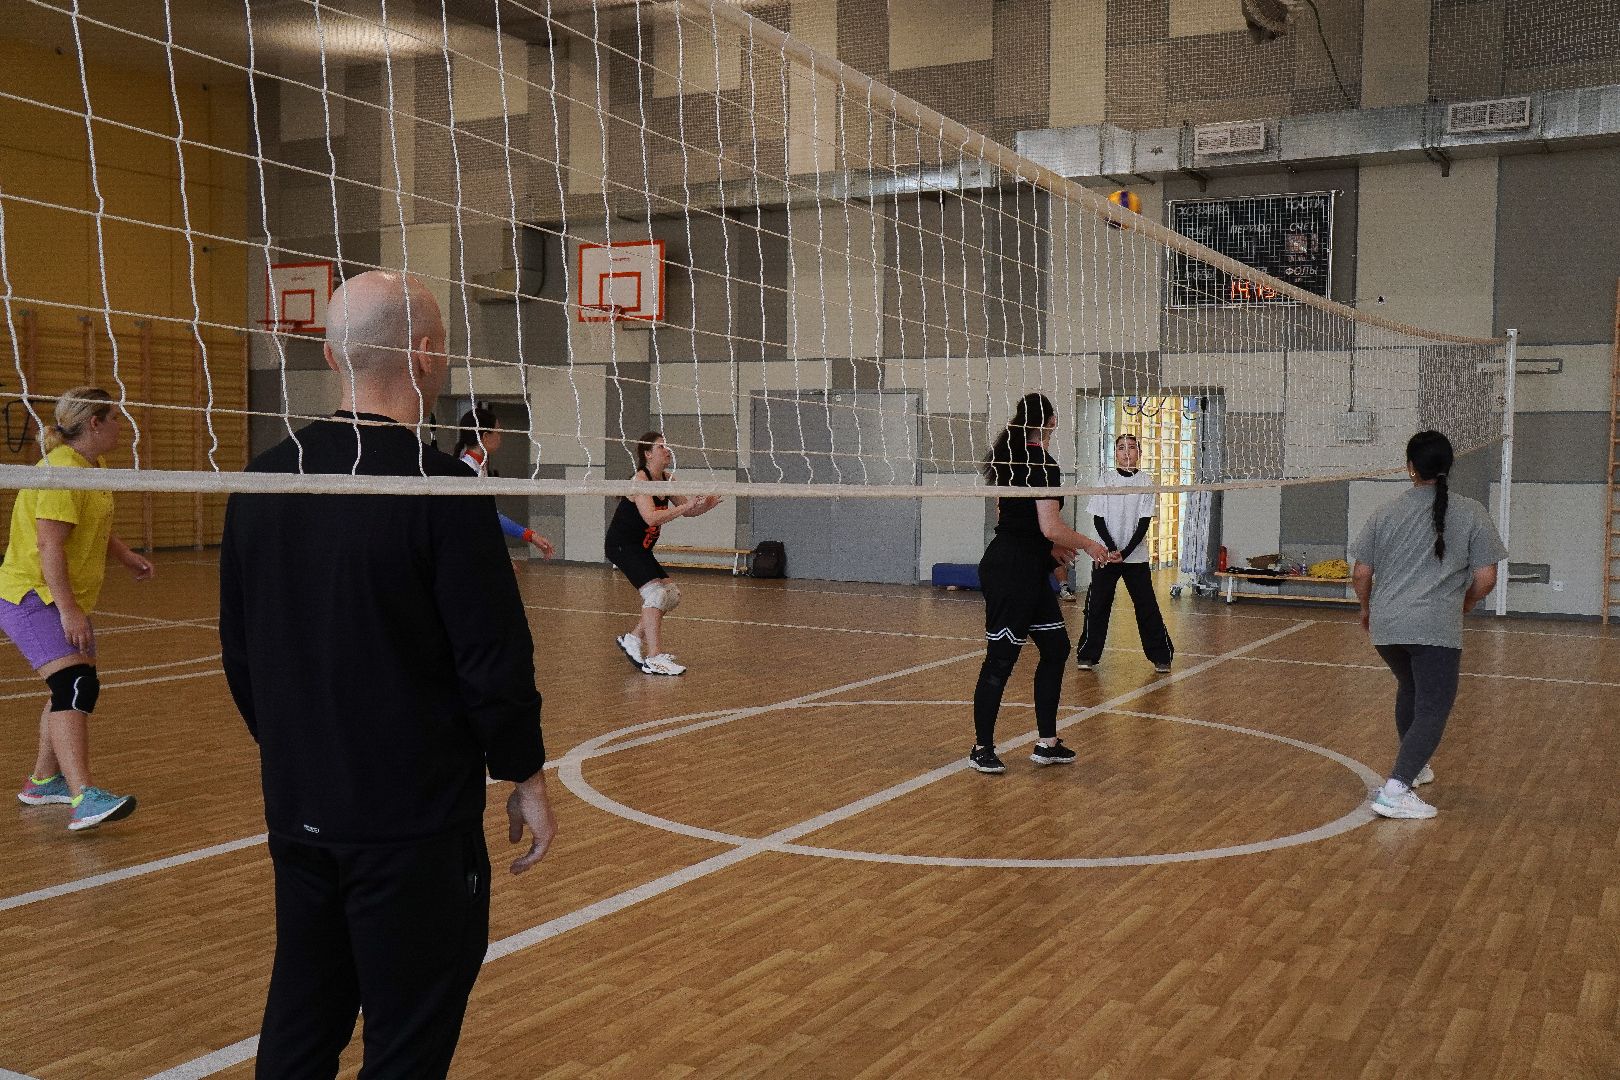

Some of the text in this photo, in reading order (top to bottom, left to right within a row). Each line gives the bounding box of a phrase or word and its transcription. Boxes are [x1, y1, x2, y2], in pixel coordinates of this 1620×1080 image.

[1179, 203, 1230, 216] ХОЗЯЕВА
[1286, 198, 1325, 211] ГОСТИ
[1230, 223, 1273, 234] ПЕРИОД
[1285, 267, 1319, 276] ФОЛЫ
